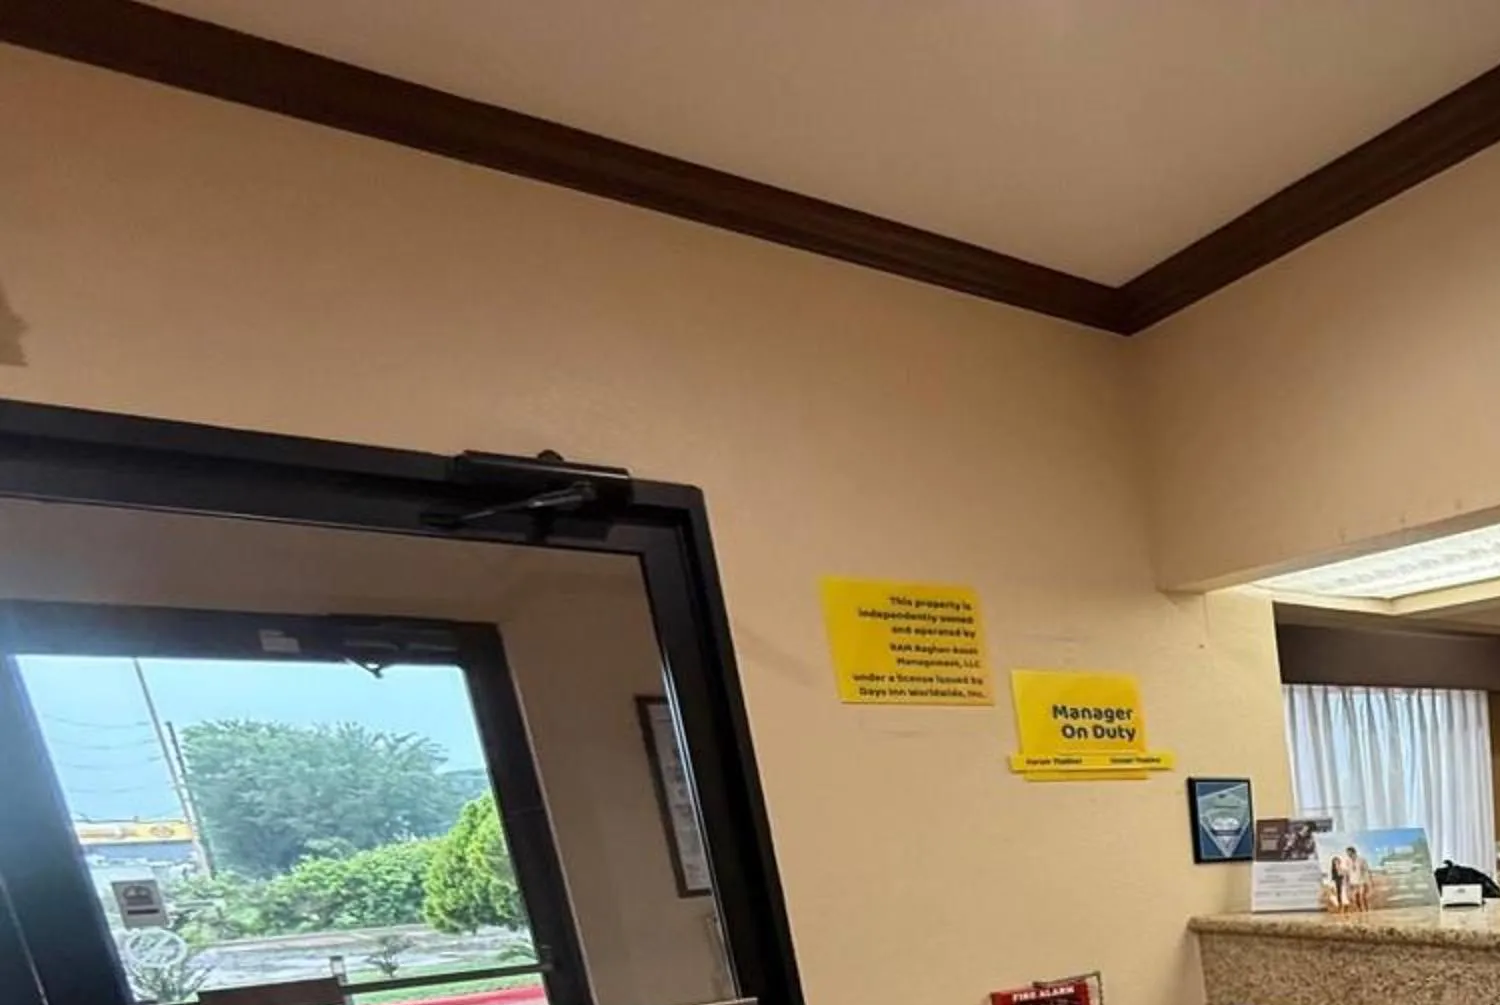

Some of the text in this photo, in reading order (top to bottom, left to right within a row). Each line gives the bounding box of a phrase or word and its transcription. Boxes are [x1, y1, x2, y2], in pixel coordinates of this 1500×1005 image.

[889, 596, 912, 607] This
[914, 600, 961, 612] property
[858, 608, 975, 625] independently owned
[892, 626, 912, 635] and
[914, 627, 961, 638] operated
[852, 673, 885, 683] under
[898, 674, 934, 683] license
[859, 686, 887, 698] Days
[1052, 704, 1133, 723] Manager
[1061, 724, 1136, 742] On Duty
[1013, 986, 1075, 1003] FIRE ALARM
